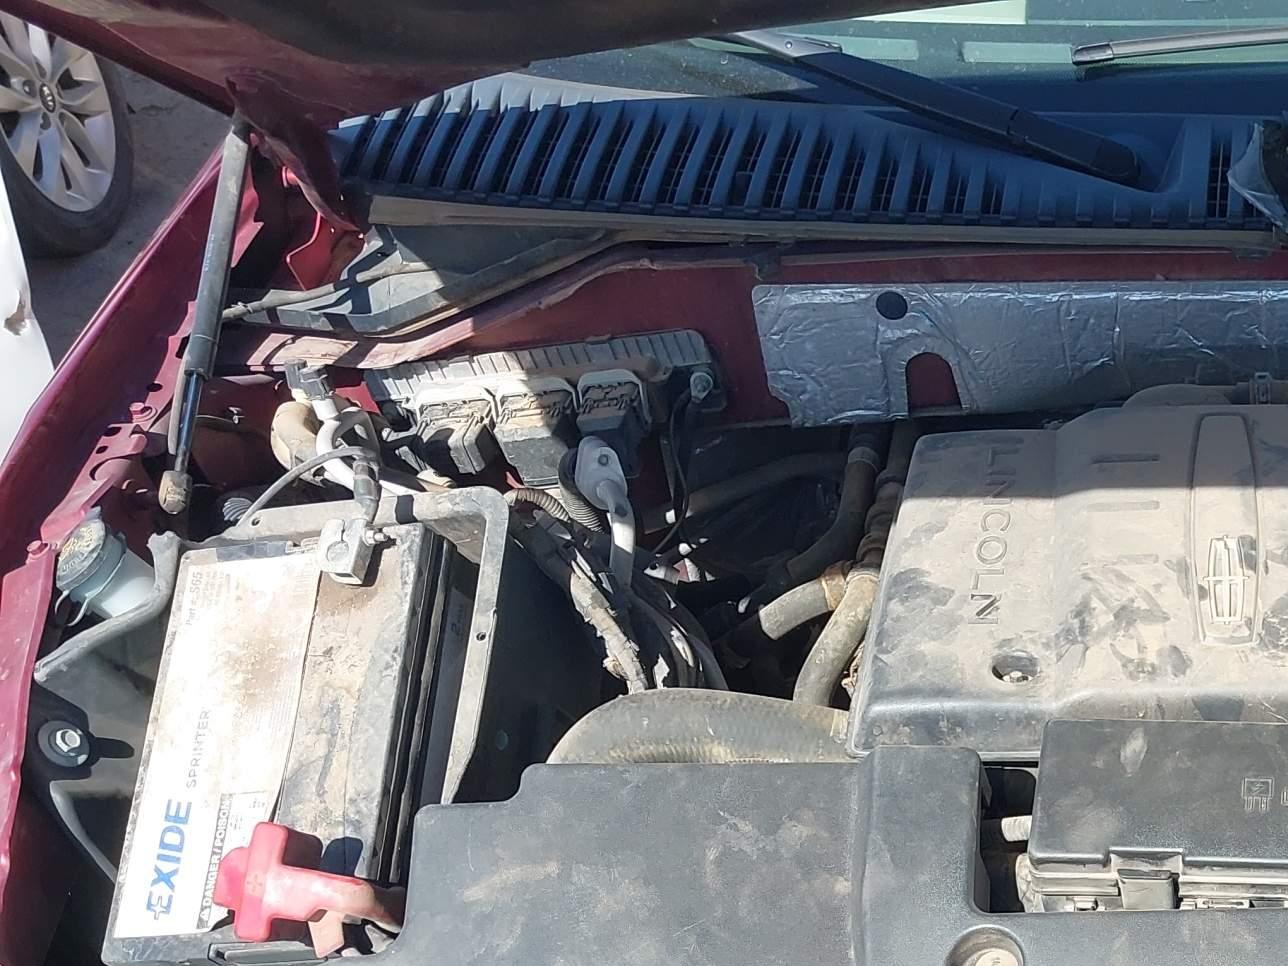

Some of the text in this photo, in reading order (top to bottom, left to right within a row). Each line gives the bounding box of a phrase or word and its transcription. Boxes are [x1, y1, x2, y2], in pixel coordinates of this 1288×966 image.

[968, 446, 1021, 625] LINCOLN
[186, 709, 212, 788] SPRINTER
[146, 799, 193, 920] EXIDE
[202, 855, 221, 906] DANGER
[214, 797, 232, 847] POISON
